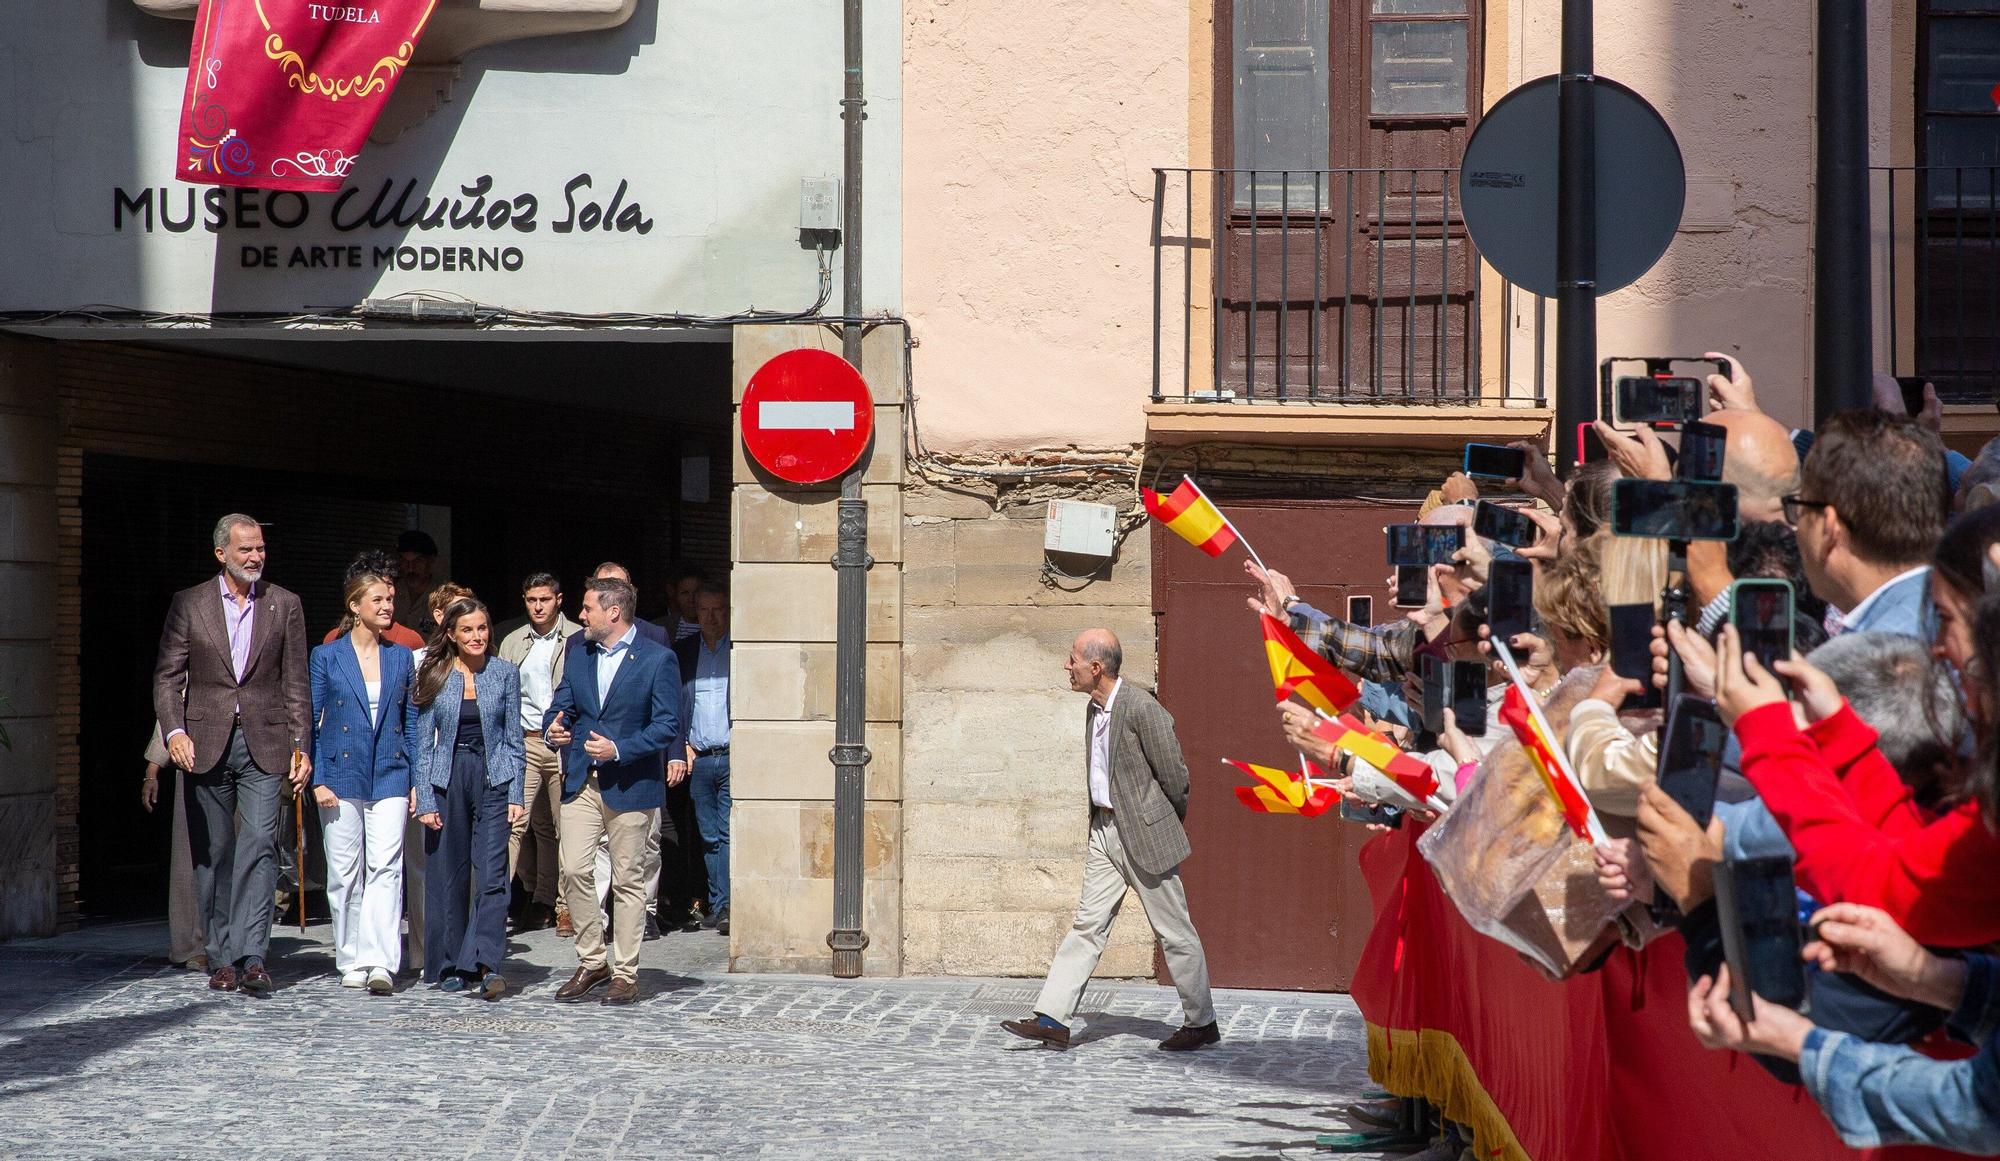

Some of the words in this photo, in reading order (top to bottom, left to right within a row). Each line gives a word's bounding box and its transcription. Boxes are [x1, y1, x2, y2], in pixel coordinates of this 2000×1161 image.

[308, 3, 380, 24] TUDELA
[113, 187, 310, 233] MUSEO
[331, 174, 539, 233] Muñoz
[551, 173, 654, 235] Sola
[241, 246, 278, 268] DE
[288, 246, 362, 268] ARTE
[373, 246, 525, 272] MODERNO
